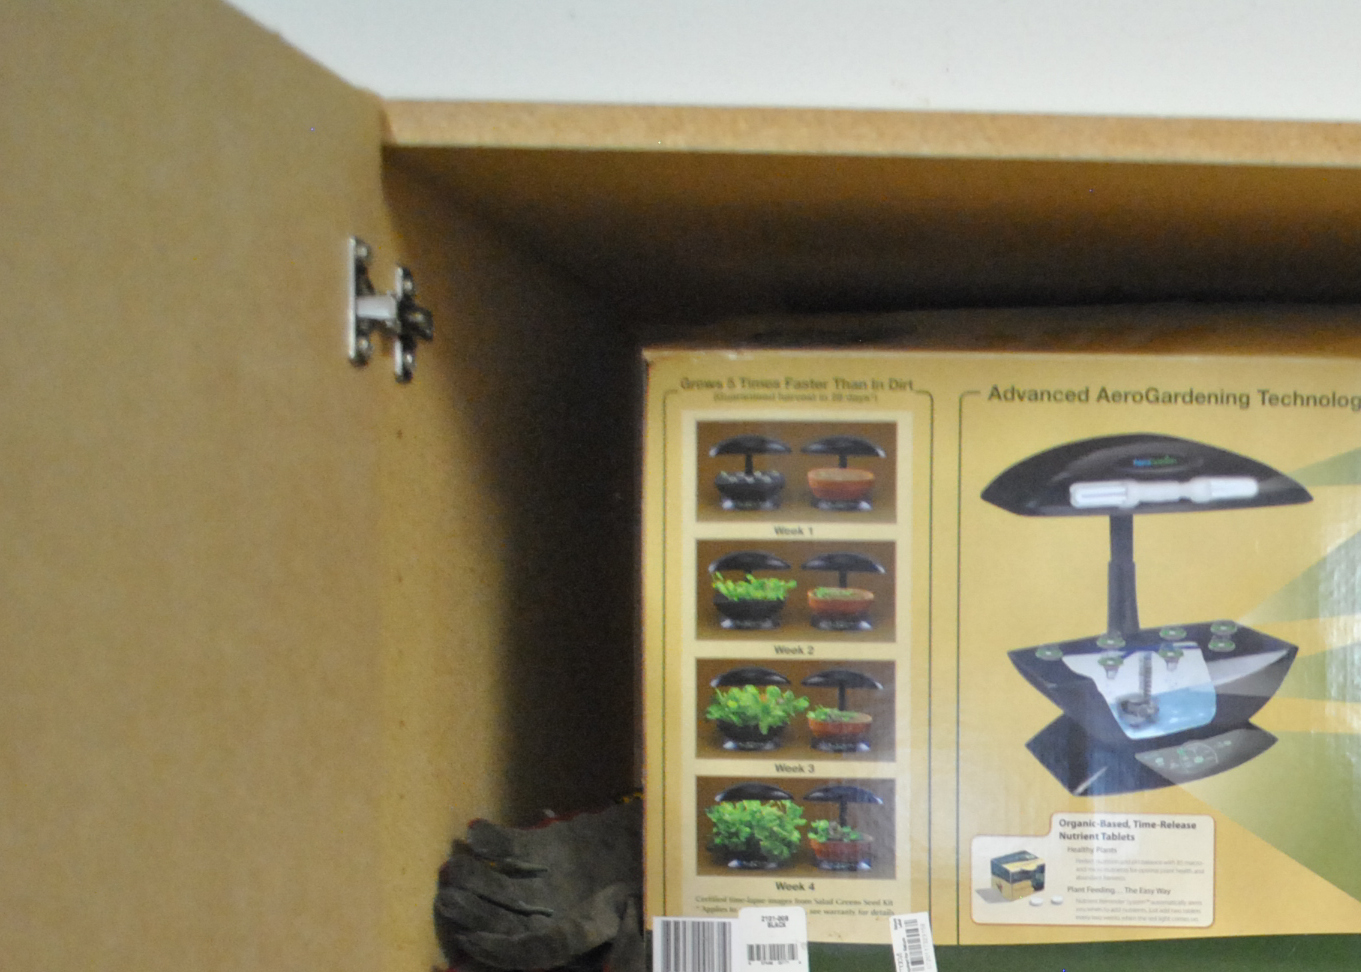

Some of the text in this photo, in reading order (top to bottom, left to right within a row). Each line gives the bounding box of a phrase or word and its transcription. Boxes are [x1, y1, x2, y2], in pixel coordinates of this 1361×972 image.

[785, 376, 828, 390] Faster
[832, 377, 868, 390] Than
[888, 378, 914, 391] Dirt
[988, 384, 1090, 402] Advanced
[1096, 386, 1251, 410] AeroGardening
[774, 525, 804, 536] Week
[774, 644, 815, 656] Week 2
[774, 762, 815, 774] Week 3
[1058, 818, 1197, 830] Organic-Based, Time-Release
[1058, 832, 1136, 842] Nutrient Tablets
[1067, 845, 1118, 855] Healthy Plants
[775, 881, 806, 891] Week
[1067, 885, 1085, 893] Plant
[1125, 886, 1138, 894] The
[1139, 887, 1155, 896] Easy
[1156, 887, 1172, 896] Way
